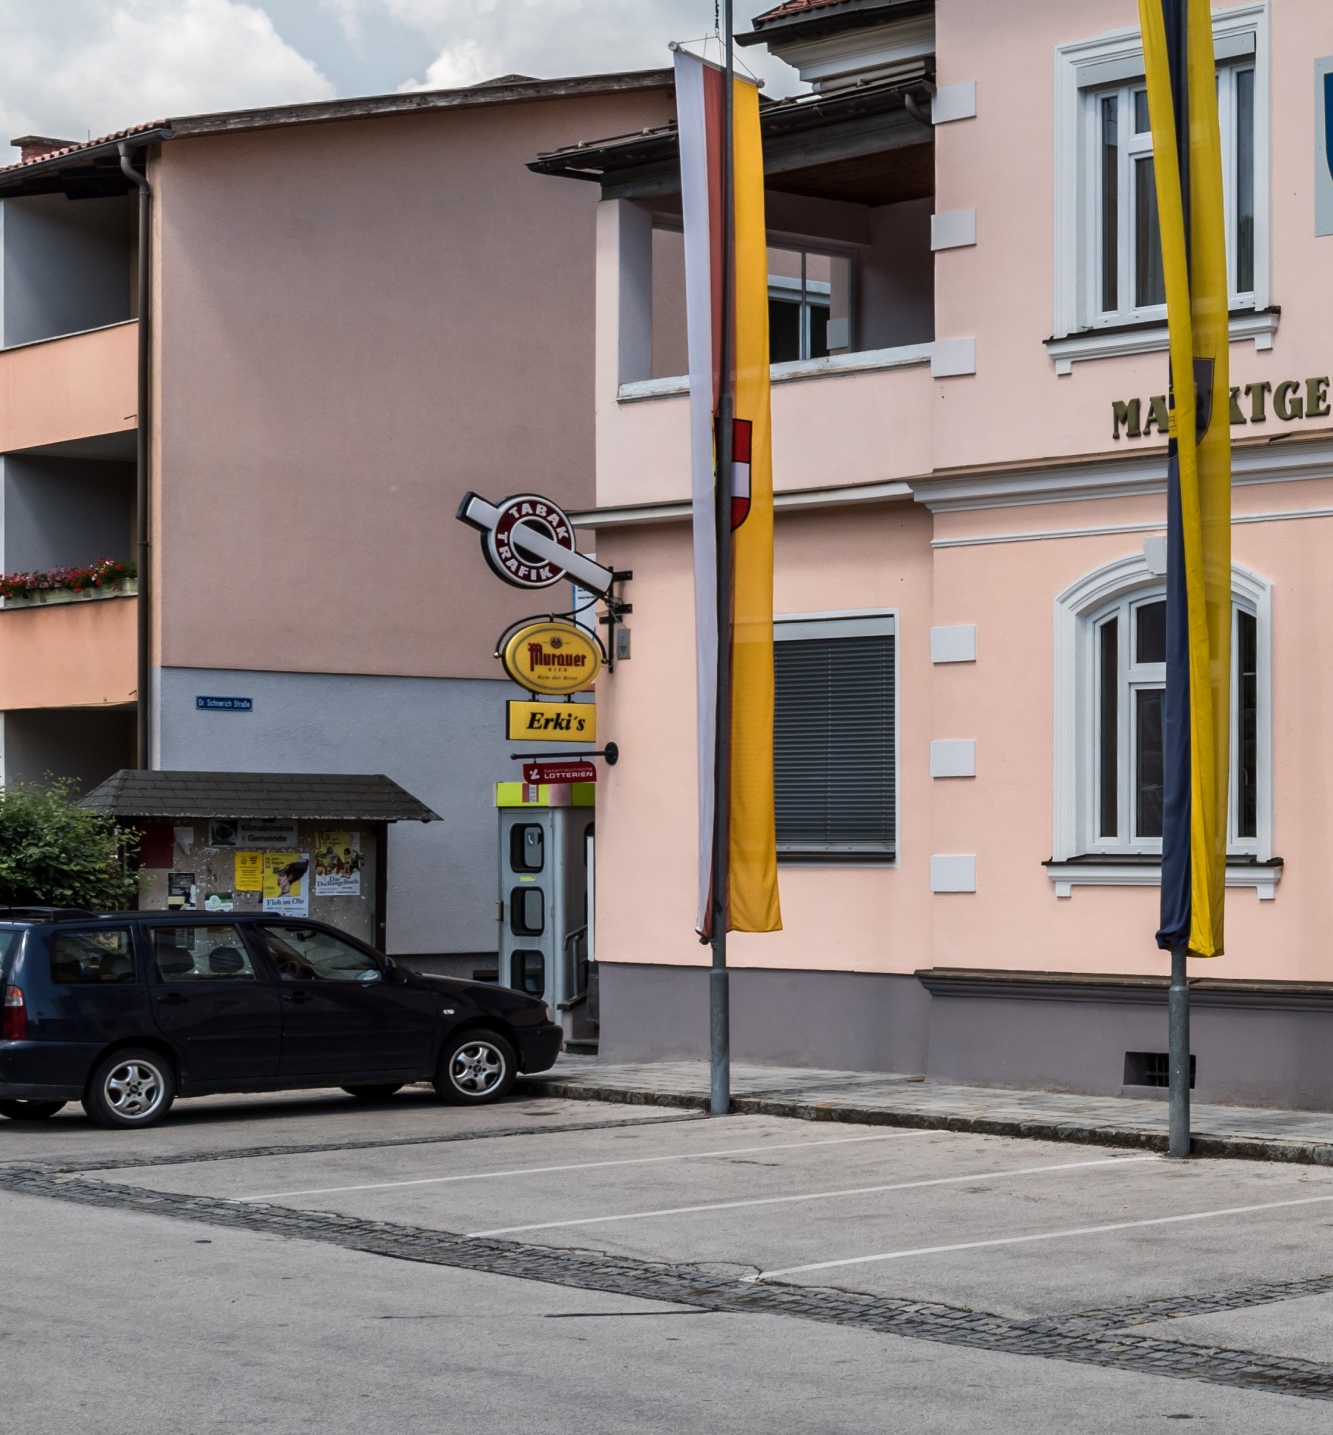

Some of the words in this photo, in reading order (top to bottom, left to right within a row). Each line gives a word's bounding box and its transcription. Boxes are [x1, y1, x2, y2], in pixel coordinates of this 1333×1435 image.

[508, 502, 569, 540] TABAK
[497, 531, 554, 581] TRAFIK
[528, 642, 587, 672] Murauer
[544, 771, 593, 779] LOTTERIEN
[248, 834, 287, 842] Gemeinde
